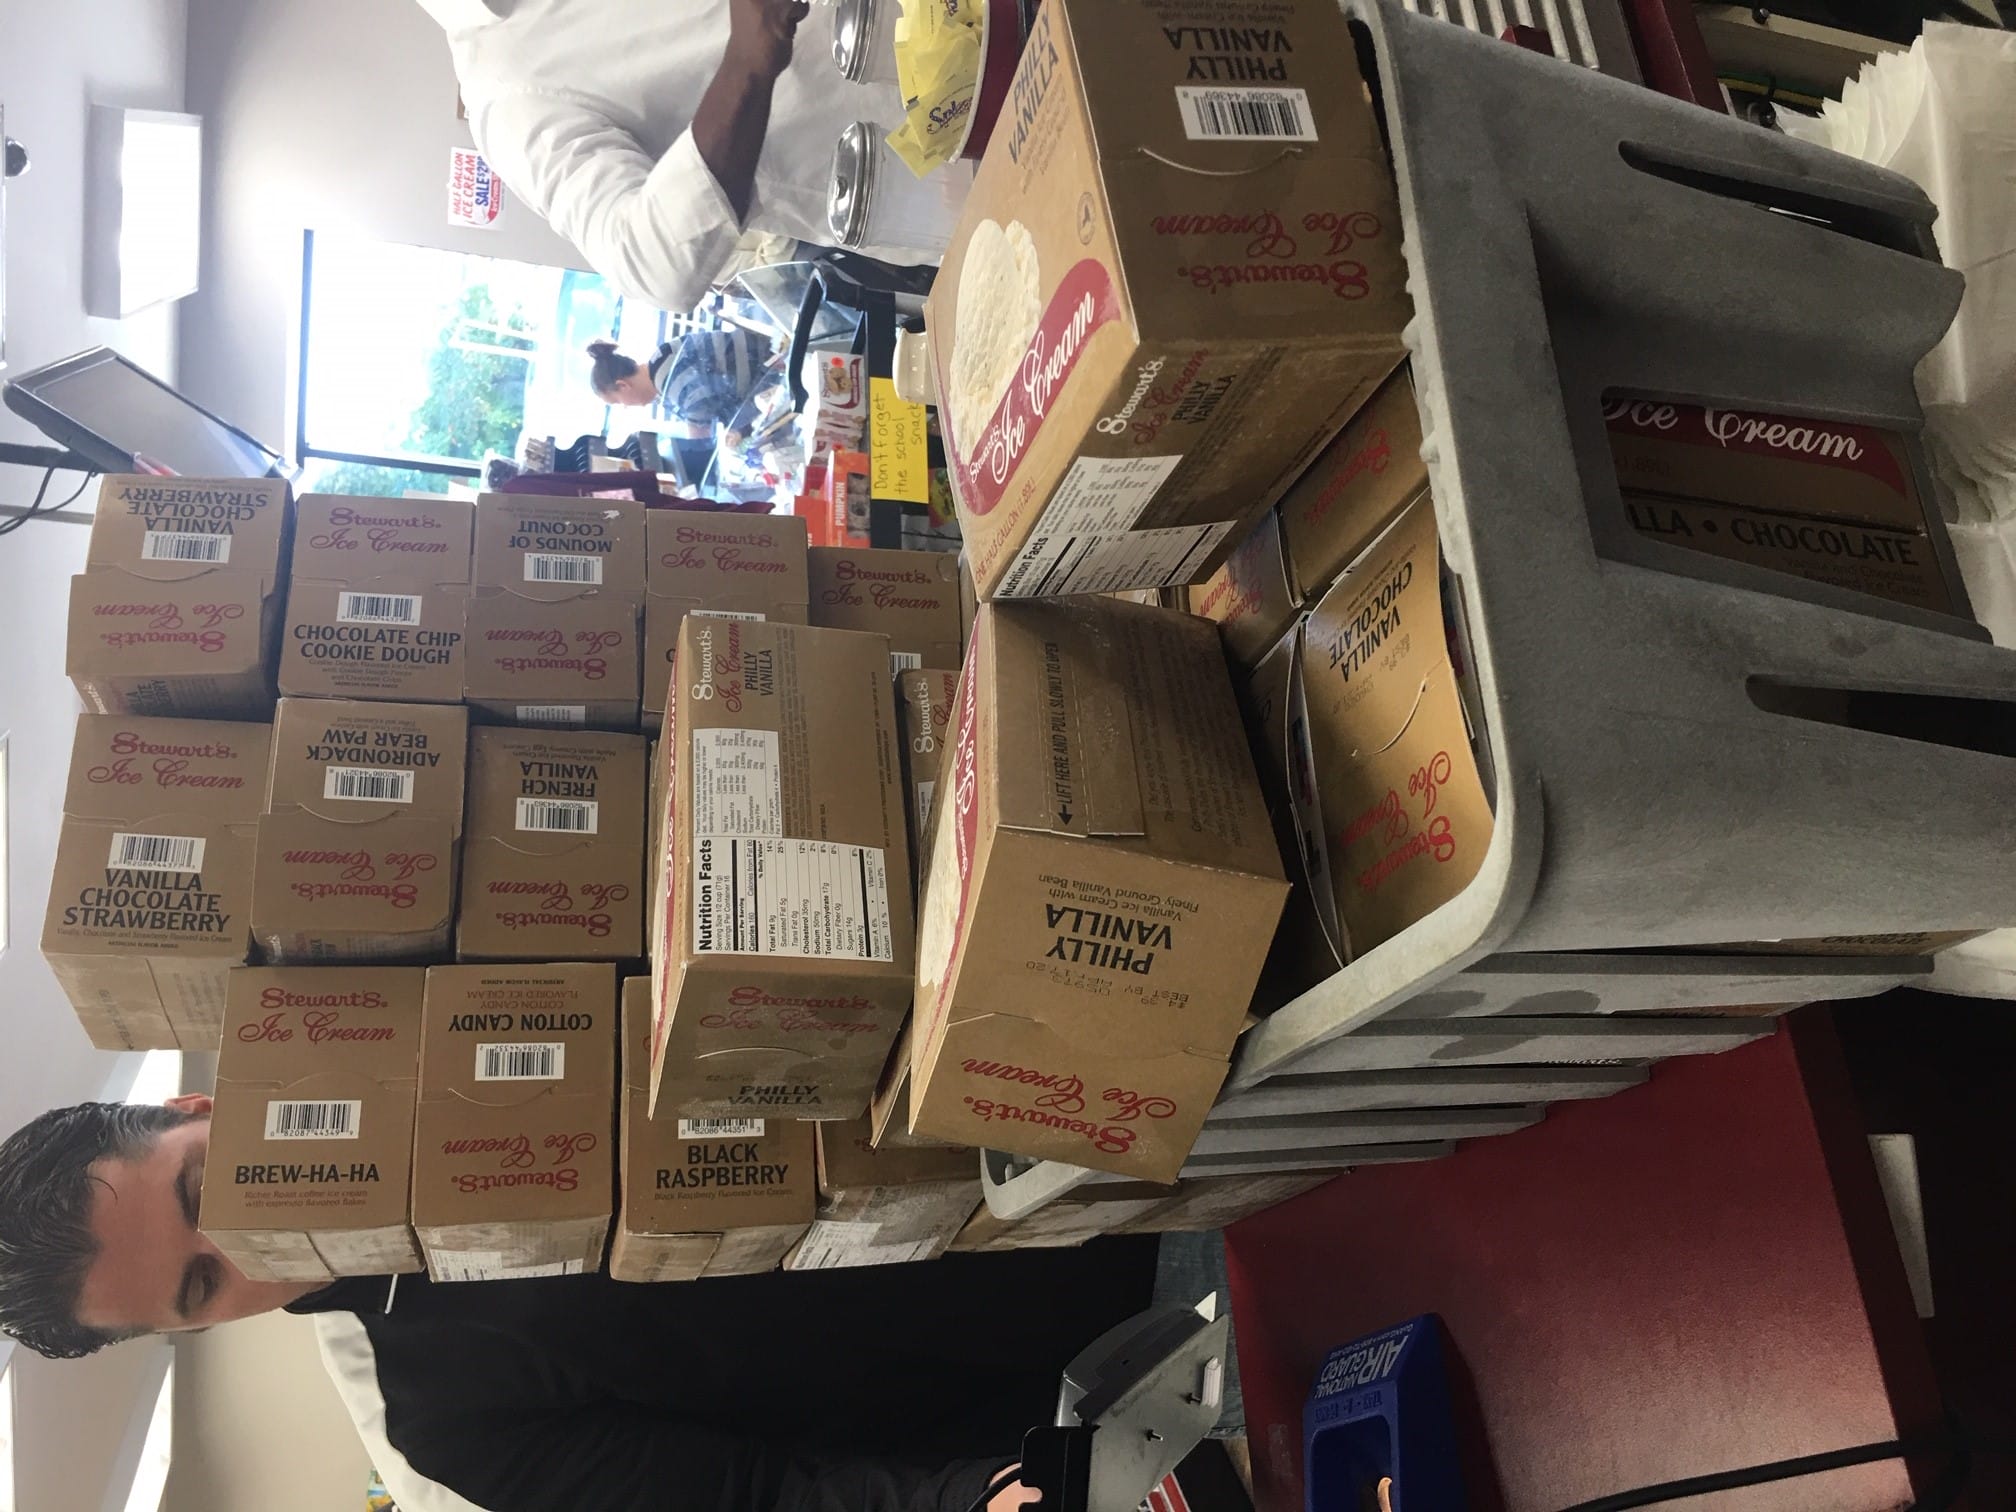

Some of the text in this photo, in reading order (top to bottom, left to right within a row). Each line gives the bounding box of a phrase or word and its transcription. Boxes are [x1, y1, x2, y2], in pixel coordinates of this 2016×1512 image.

[1162, 28, 1293, 52] VANILLA
[1013, 13, 1050, 115] PHILLY
[1186, 56, 1287, 81] PHILLY
[1008, 44, 1059, 164] VANILLA
[452, 152, 463, 215] HALF GALLON
[462, 155, 475, 218] ICE CREAM
[475, 178, 490, 206] SALE
[1152, 209, 1382, 258] Ice Cream
[1190, 260, 1370, 300] Stewart's
[992, 291, 1095, 485] Ice Cream
[1096, 358, 1165, 434] Stewart's
[872, 393, 891, 489] Don't forget
[1703, 408, 1864, 461] Cream
[892, 417, 908, 495] the school
[118, 487, 268, 507] STRAWBERRY
[127, 501, 256, 521] CHOCOLATE
[835, 482, 845, 527] PUMPKIN
[145, 516, 235, 535] VANILLA
[329, 507, 438, 529] Stewart's
[518, 520, 604, 537] COCONUT
[310, 528, 449, 553] Ice Cream
[508, 535, 613, 553] MOUNDS OF
[676, 526, 775, 547] Stewart's
[1730, 517, 1919, 566] CHOCOLATE
[661, 547, 788, 573] Ice Cream
[836, 560, 929, 583] Stewart's
[999, 537, 1048, 597] Nutrition Facts
[822, 584, 940, 610] Ice Cream
[93, 602, 244, 629] Ice Cream
[1329, 561, 1413, 670] CHOCOLATE
[294, 624, 461, 647] CHOCOLATE CHIP
[485, 628, 622, 656] Ice Cream
[1341, 605, 1400, 683] VANILLA
[300, 642, 451, 664] COOKIE DOUGH
[692, 628, 713, 701] Stewart's
[714, 623, 743, 713] Ice Cream
[744, 651, 758, 691] PHILLY
[760, 650, 773, 696] VANILLA
[913, 682, 935, 753] Stewart's
[1044, 642, 1072, 804] LIFT HERE AND PULL SLOWLY TO OPEN
[110, 731, 235, 759] Stewart's
[322, 729, 427, 749] BEAR PAW
[306, 745, 441, 767] ADIRONDACK
[87, 757, 244, 790] Ice Cream
[520, 761, 598, 780] VANILLA
[521, 779, 595, 798] FRENCH
[1408, 751, 1451, 820] Ice
[284, 849, 438, 881] Ice Cream
[105, 868, 202, 891] VANILLA
[1038, 874, 1199, 912] Finely Ground Vanilla Bean
[79, 887, 222, 912] CHOCOLATE
[294, 883, 418, 909] Stewart's
[488, 880, 629, 911] Ice Cream
[698, 839, 713, 950] Nutrition Facts
[1048, 888, 1182, 921] Vanilla Ice Cream with
[62, 906, 231, 933] STRAWBERRY
[499, 912, 612, 937] Stewart's
[823, 895, 831, 937] Carbohydrate
[1045, 903, 1172, 951] VANILLA
[748, 925, 756, 951] Calories
[802, 917, 810, 954] Cholesterol
[857, 934, 865, 956] Protein
[1045, 936, 1155, 975] PHILLY
[260, 988, 386, 1009] Stewart's
[467, 990, 505, 999] CREAM
[480, 1000, 564, 1009] COTTON CANDY
[509, 990, 523, 999] ICE
[1124, 985, 1144, 996] BY
[1150, 990, 1190, 1003] BEST
[238, 1011, 396, 1045] Ice Cream
[448, 1013, 593, 1032] COTTON CANDY
[727, 1096, 823, 1105] VANILLA
[739, 1085, 820, 1095] PHILLY
[961, 1056, 1177, 1121] Ice Cream
[694, 1126, 719, 1134] 82086
[963, 1096, 1137, 1156] Stewart's
[442, 1132, 597, 1168] Ice Cream
[687, 1143, 759, 1164] BLACK
[235, 1163, 380, 1184] BREW-HA-HA
[453, 1168, 579, 1193] Stewart's
[656, 1164, 789, 1189] RASPBERRY
[1320, 1349, 1367, 1383] GUARD
[1357, 1335, 1408, 1384] AIR
